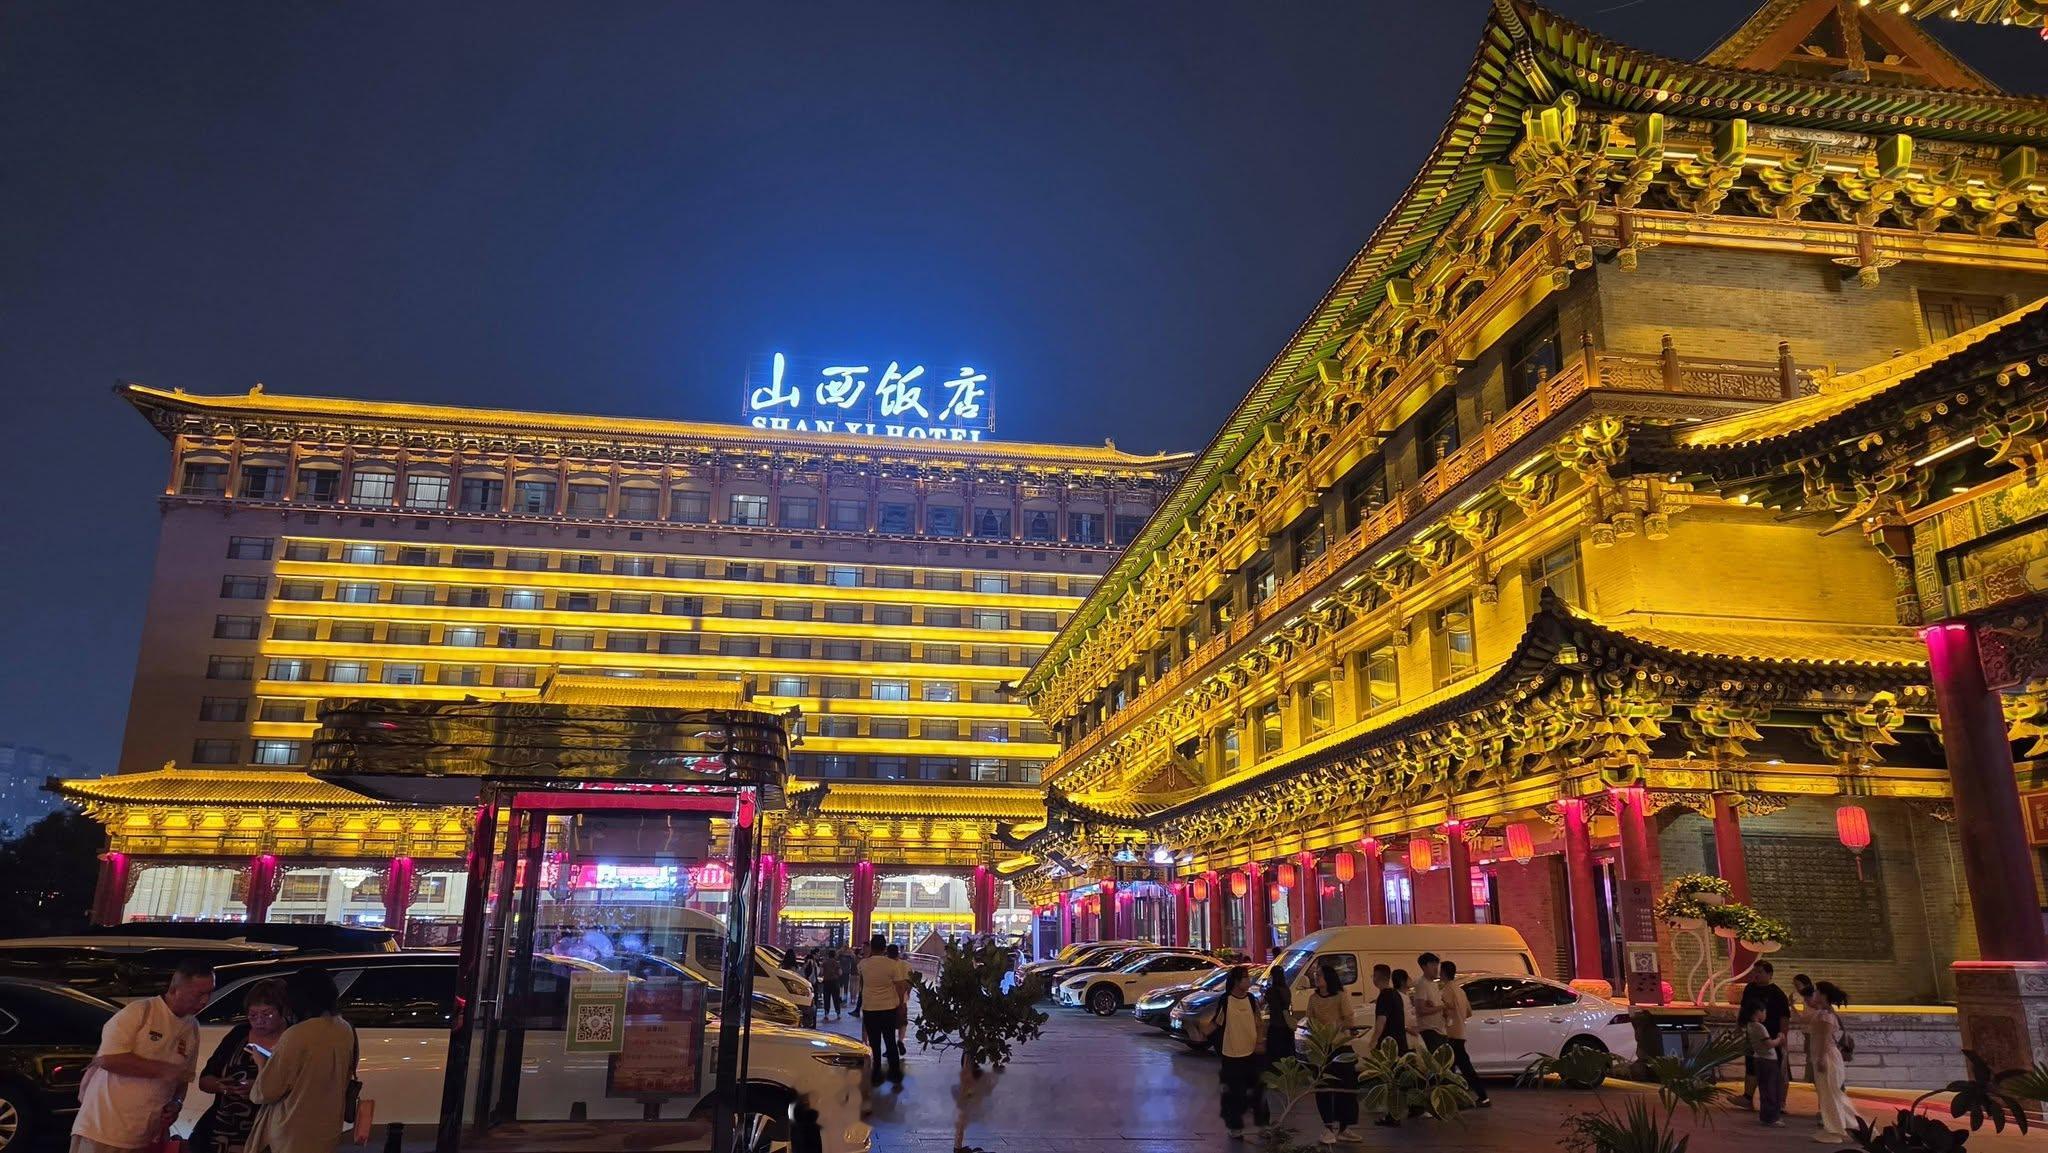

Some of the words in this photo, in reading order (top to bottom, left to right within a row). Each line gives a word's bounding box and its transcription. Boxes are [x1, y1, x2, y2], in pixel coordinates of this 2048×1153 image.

[751, 352, 987, 420] 山西饭店
[752, 416, 835, 433] SHAN
[885, 425, 981, 442] HOTEL
